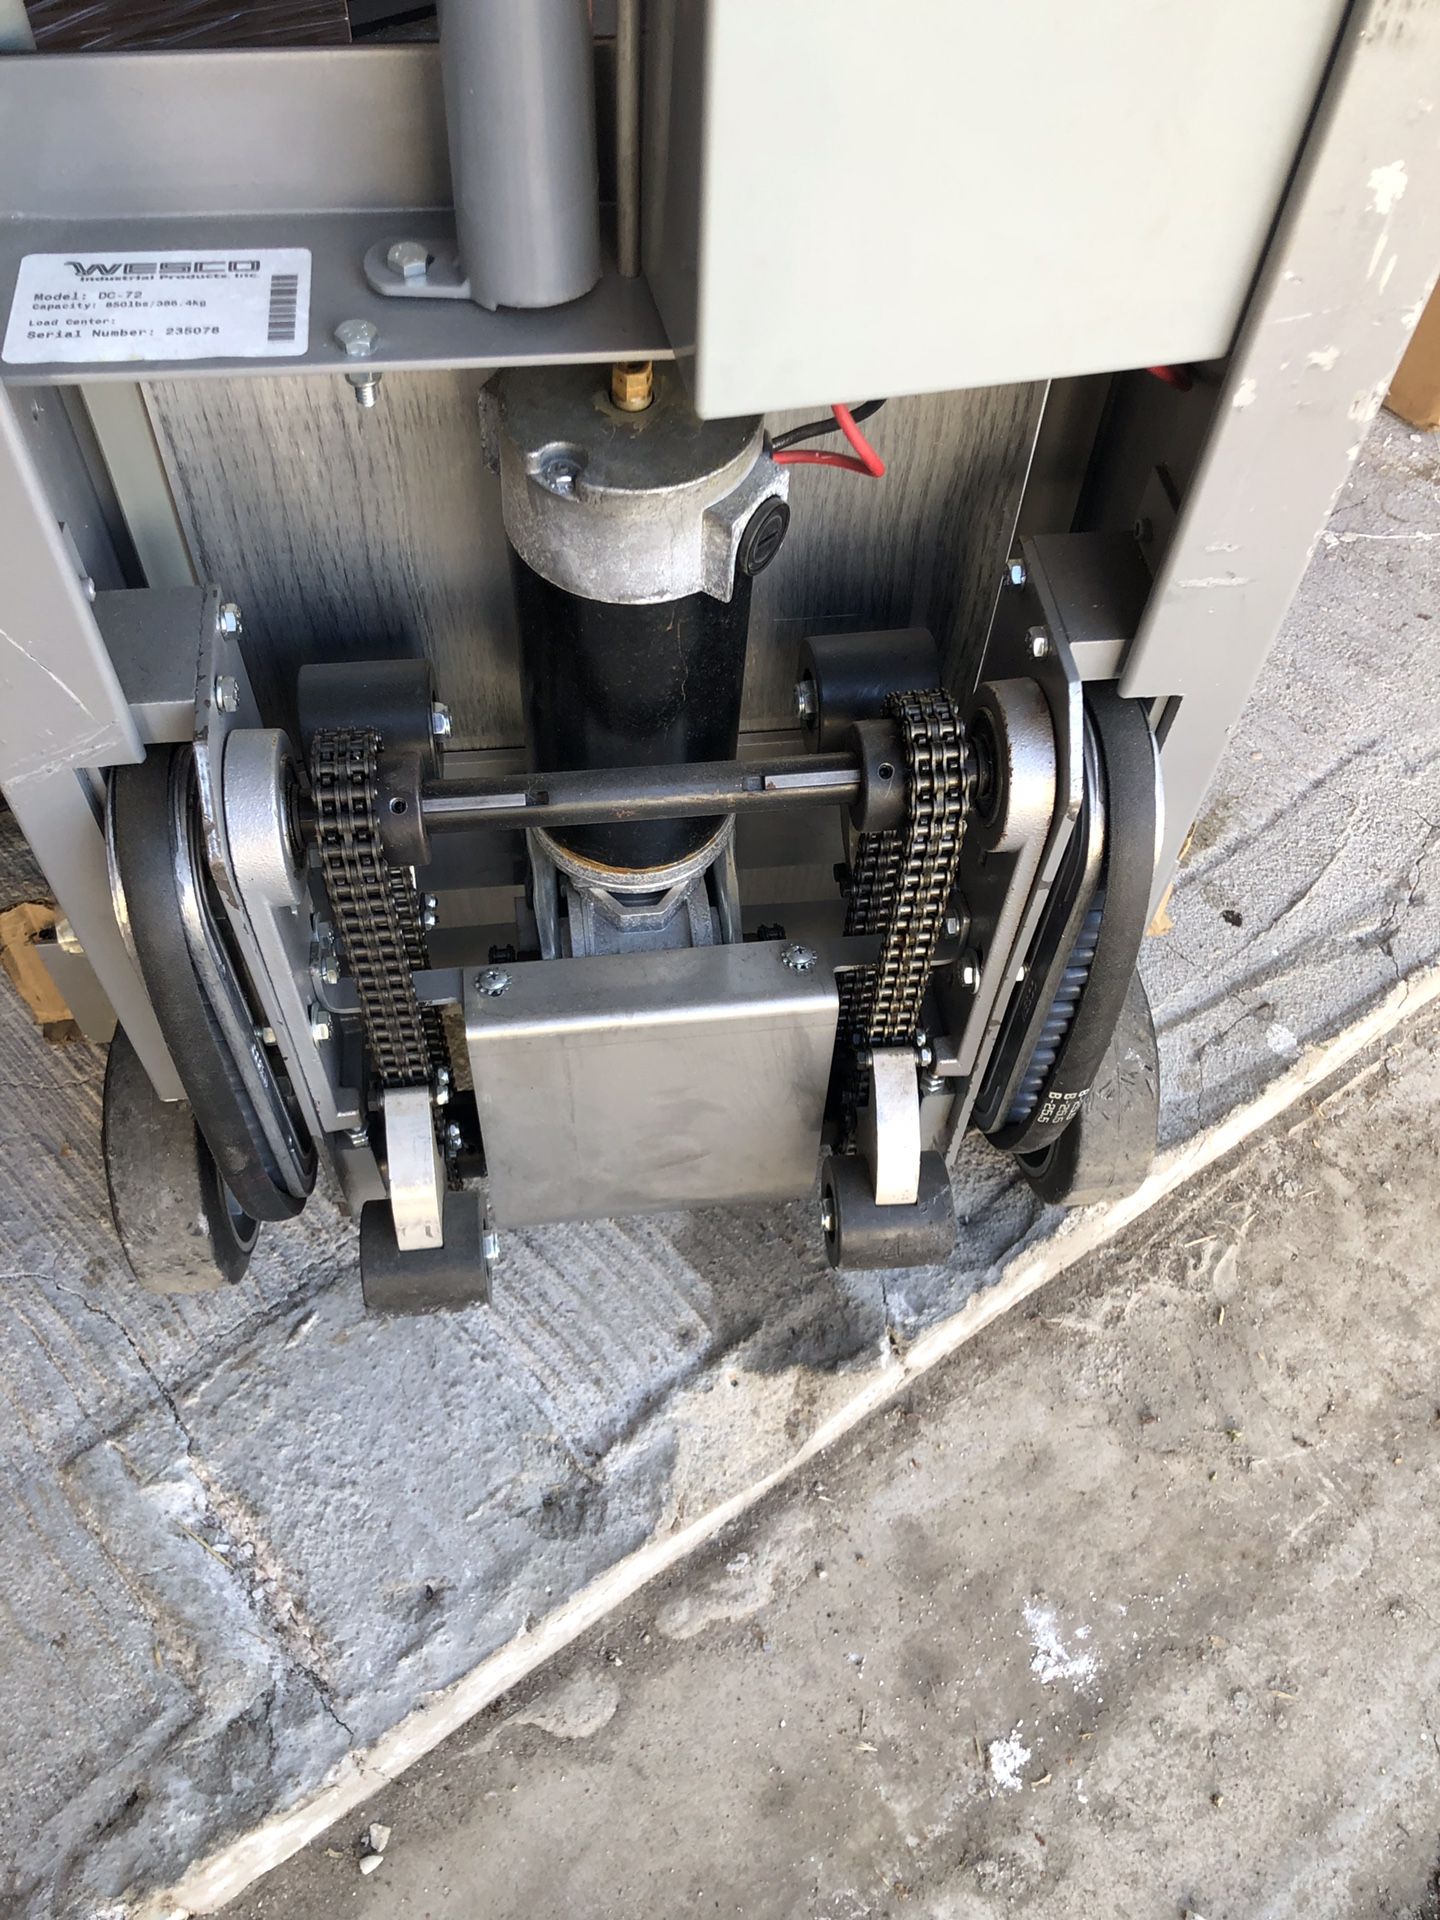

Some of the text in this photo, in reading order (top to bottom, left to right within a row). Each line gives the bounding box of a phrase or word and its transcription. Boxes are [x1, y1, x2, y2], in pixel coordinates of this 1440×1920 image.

[64, 261, 261, 277] WESCO
[33, 290, 143, 301] Model: DC-72
[32, 301, 97, 311] Capacity:
[28, 317, 116, 327] Load Center:
[26, 329, 82, 339] Serial
[91, 328, 155, 338] Number:
